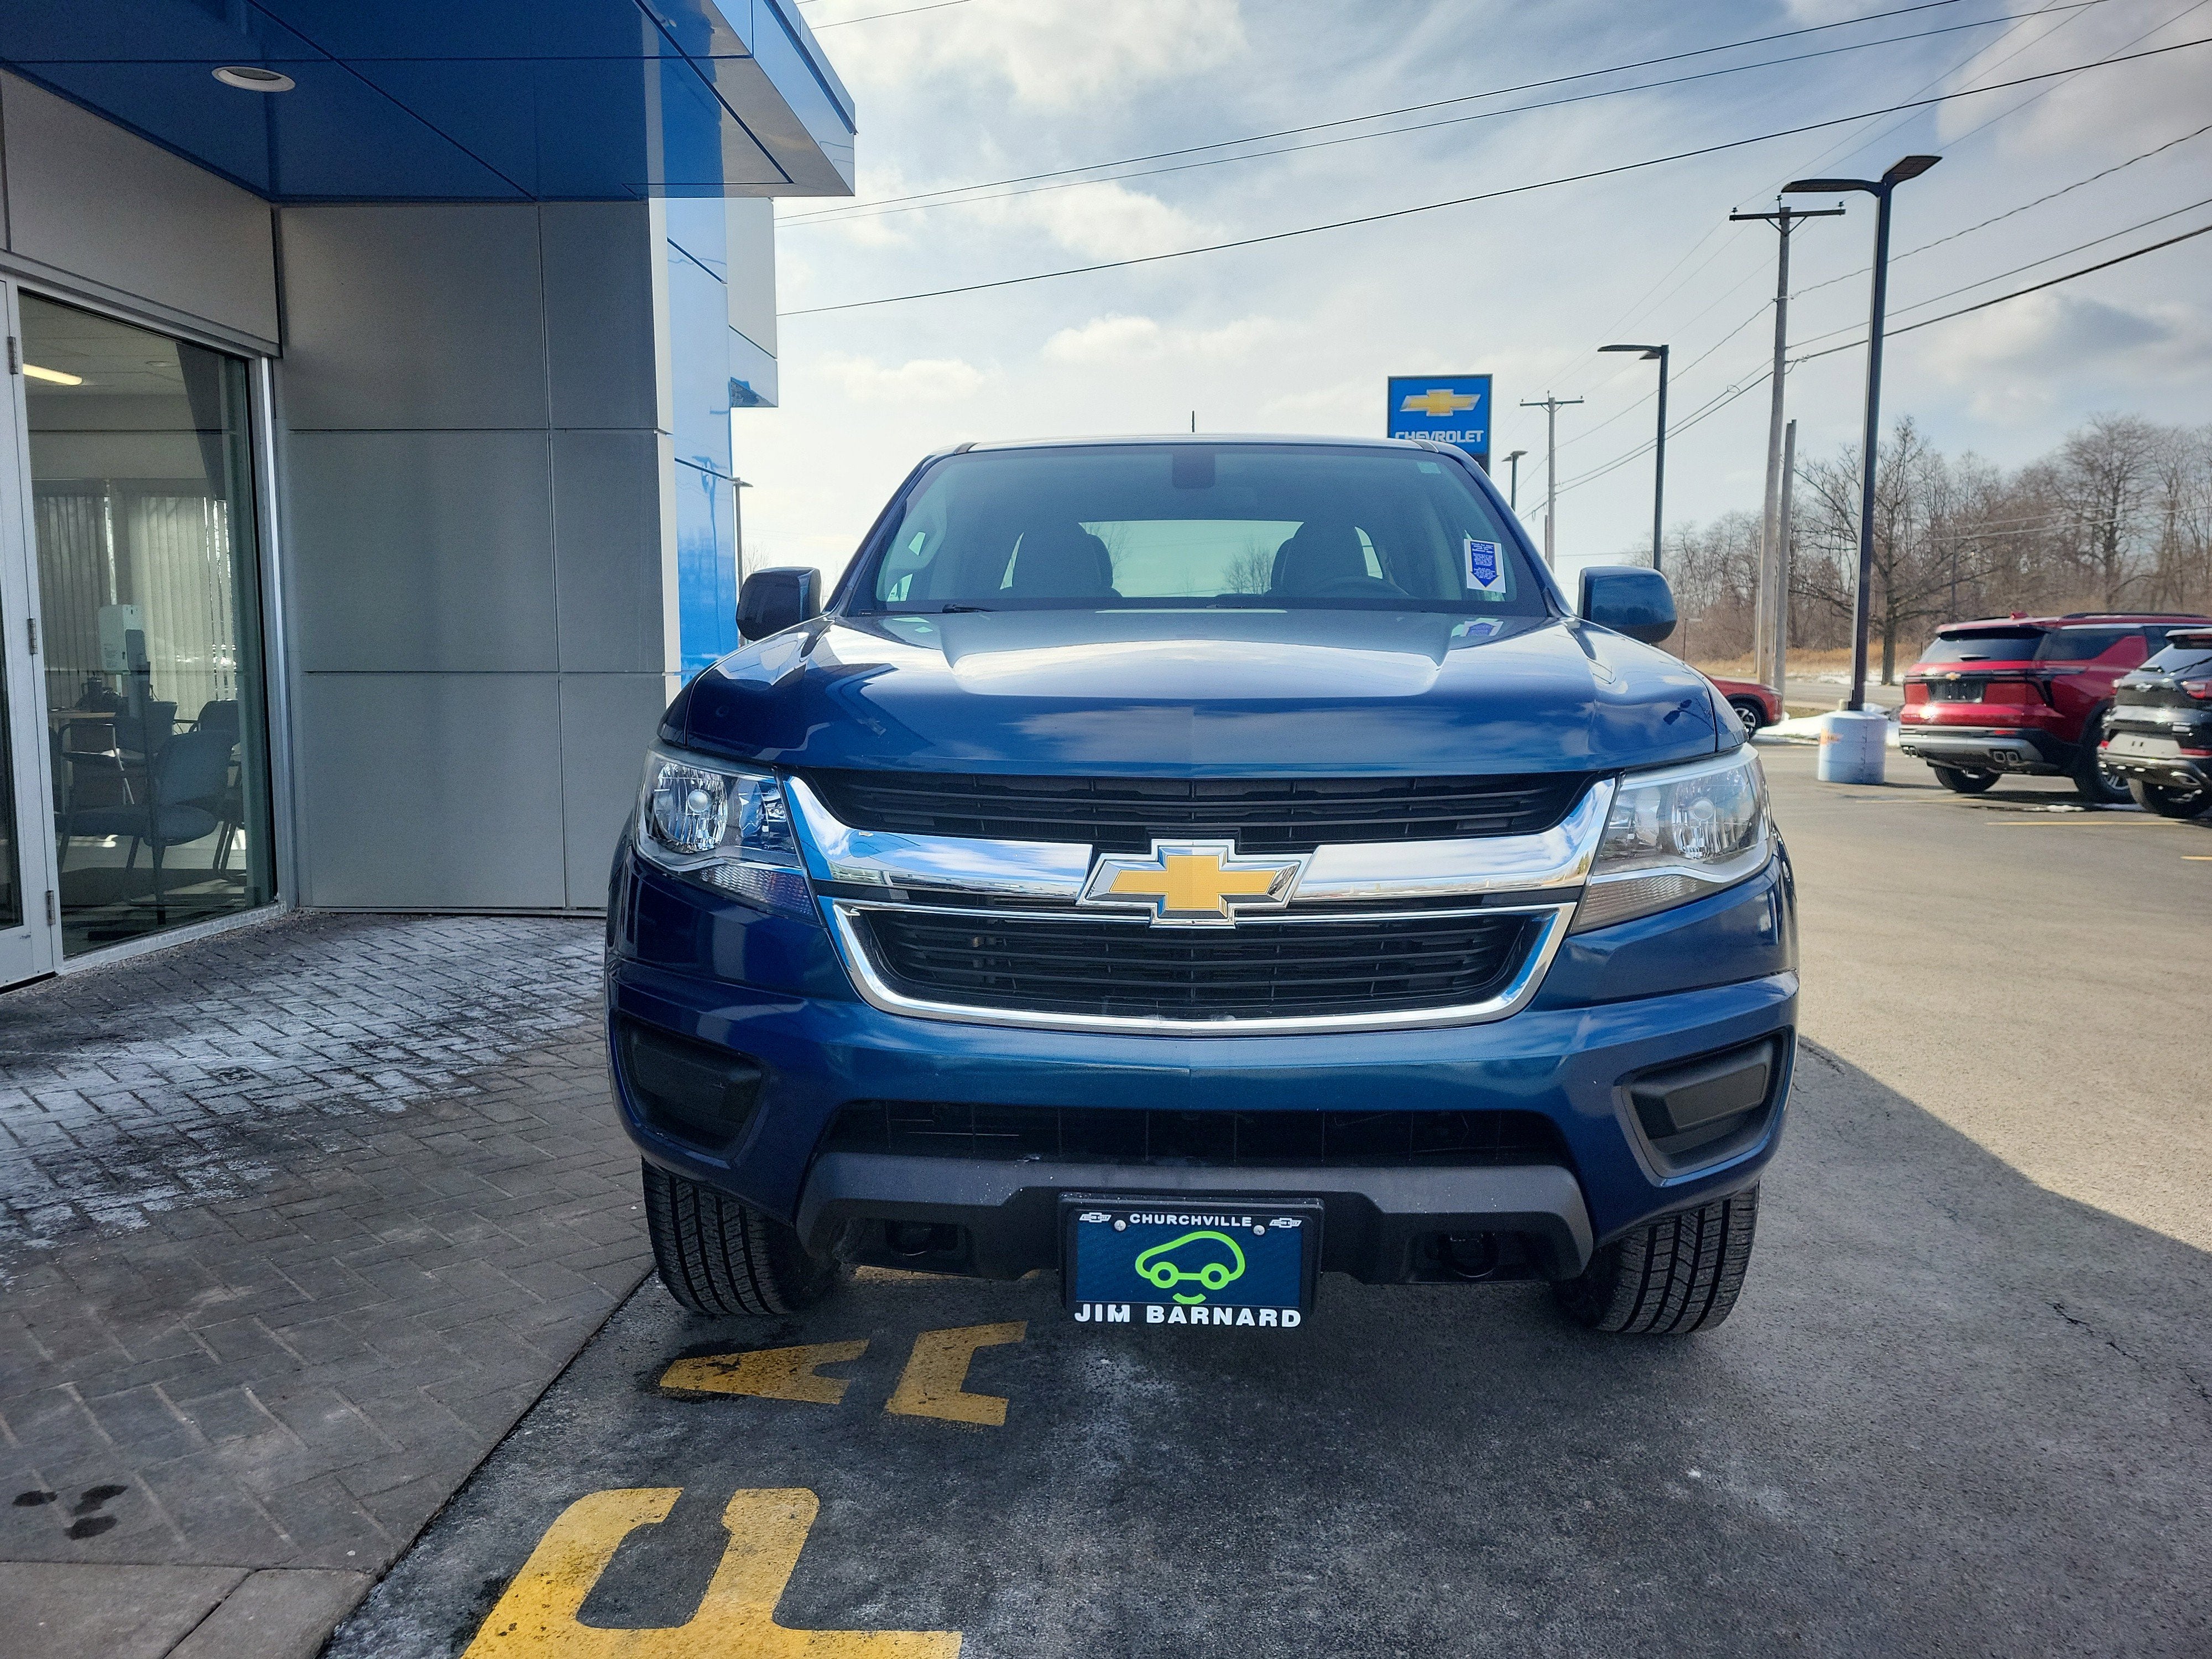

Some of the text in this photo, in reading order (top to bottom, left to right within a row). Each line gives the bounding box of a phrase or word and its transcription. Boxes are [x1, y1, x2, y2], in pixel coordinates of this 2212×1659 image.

[1395, 430, 1484, 442] CHEVROLET
[1129, 1213, 1253, 1227] CHURCHVILLE
[1074, 1303, 1301, 1328] JIM BARNARD
